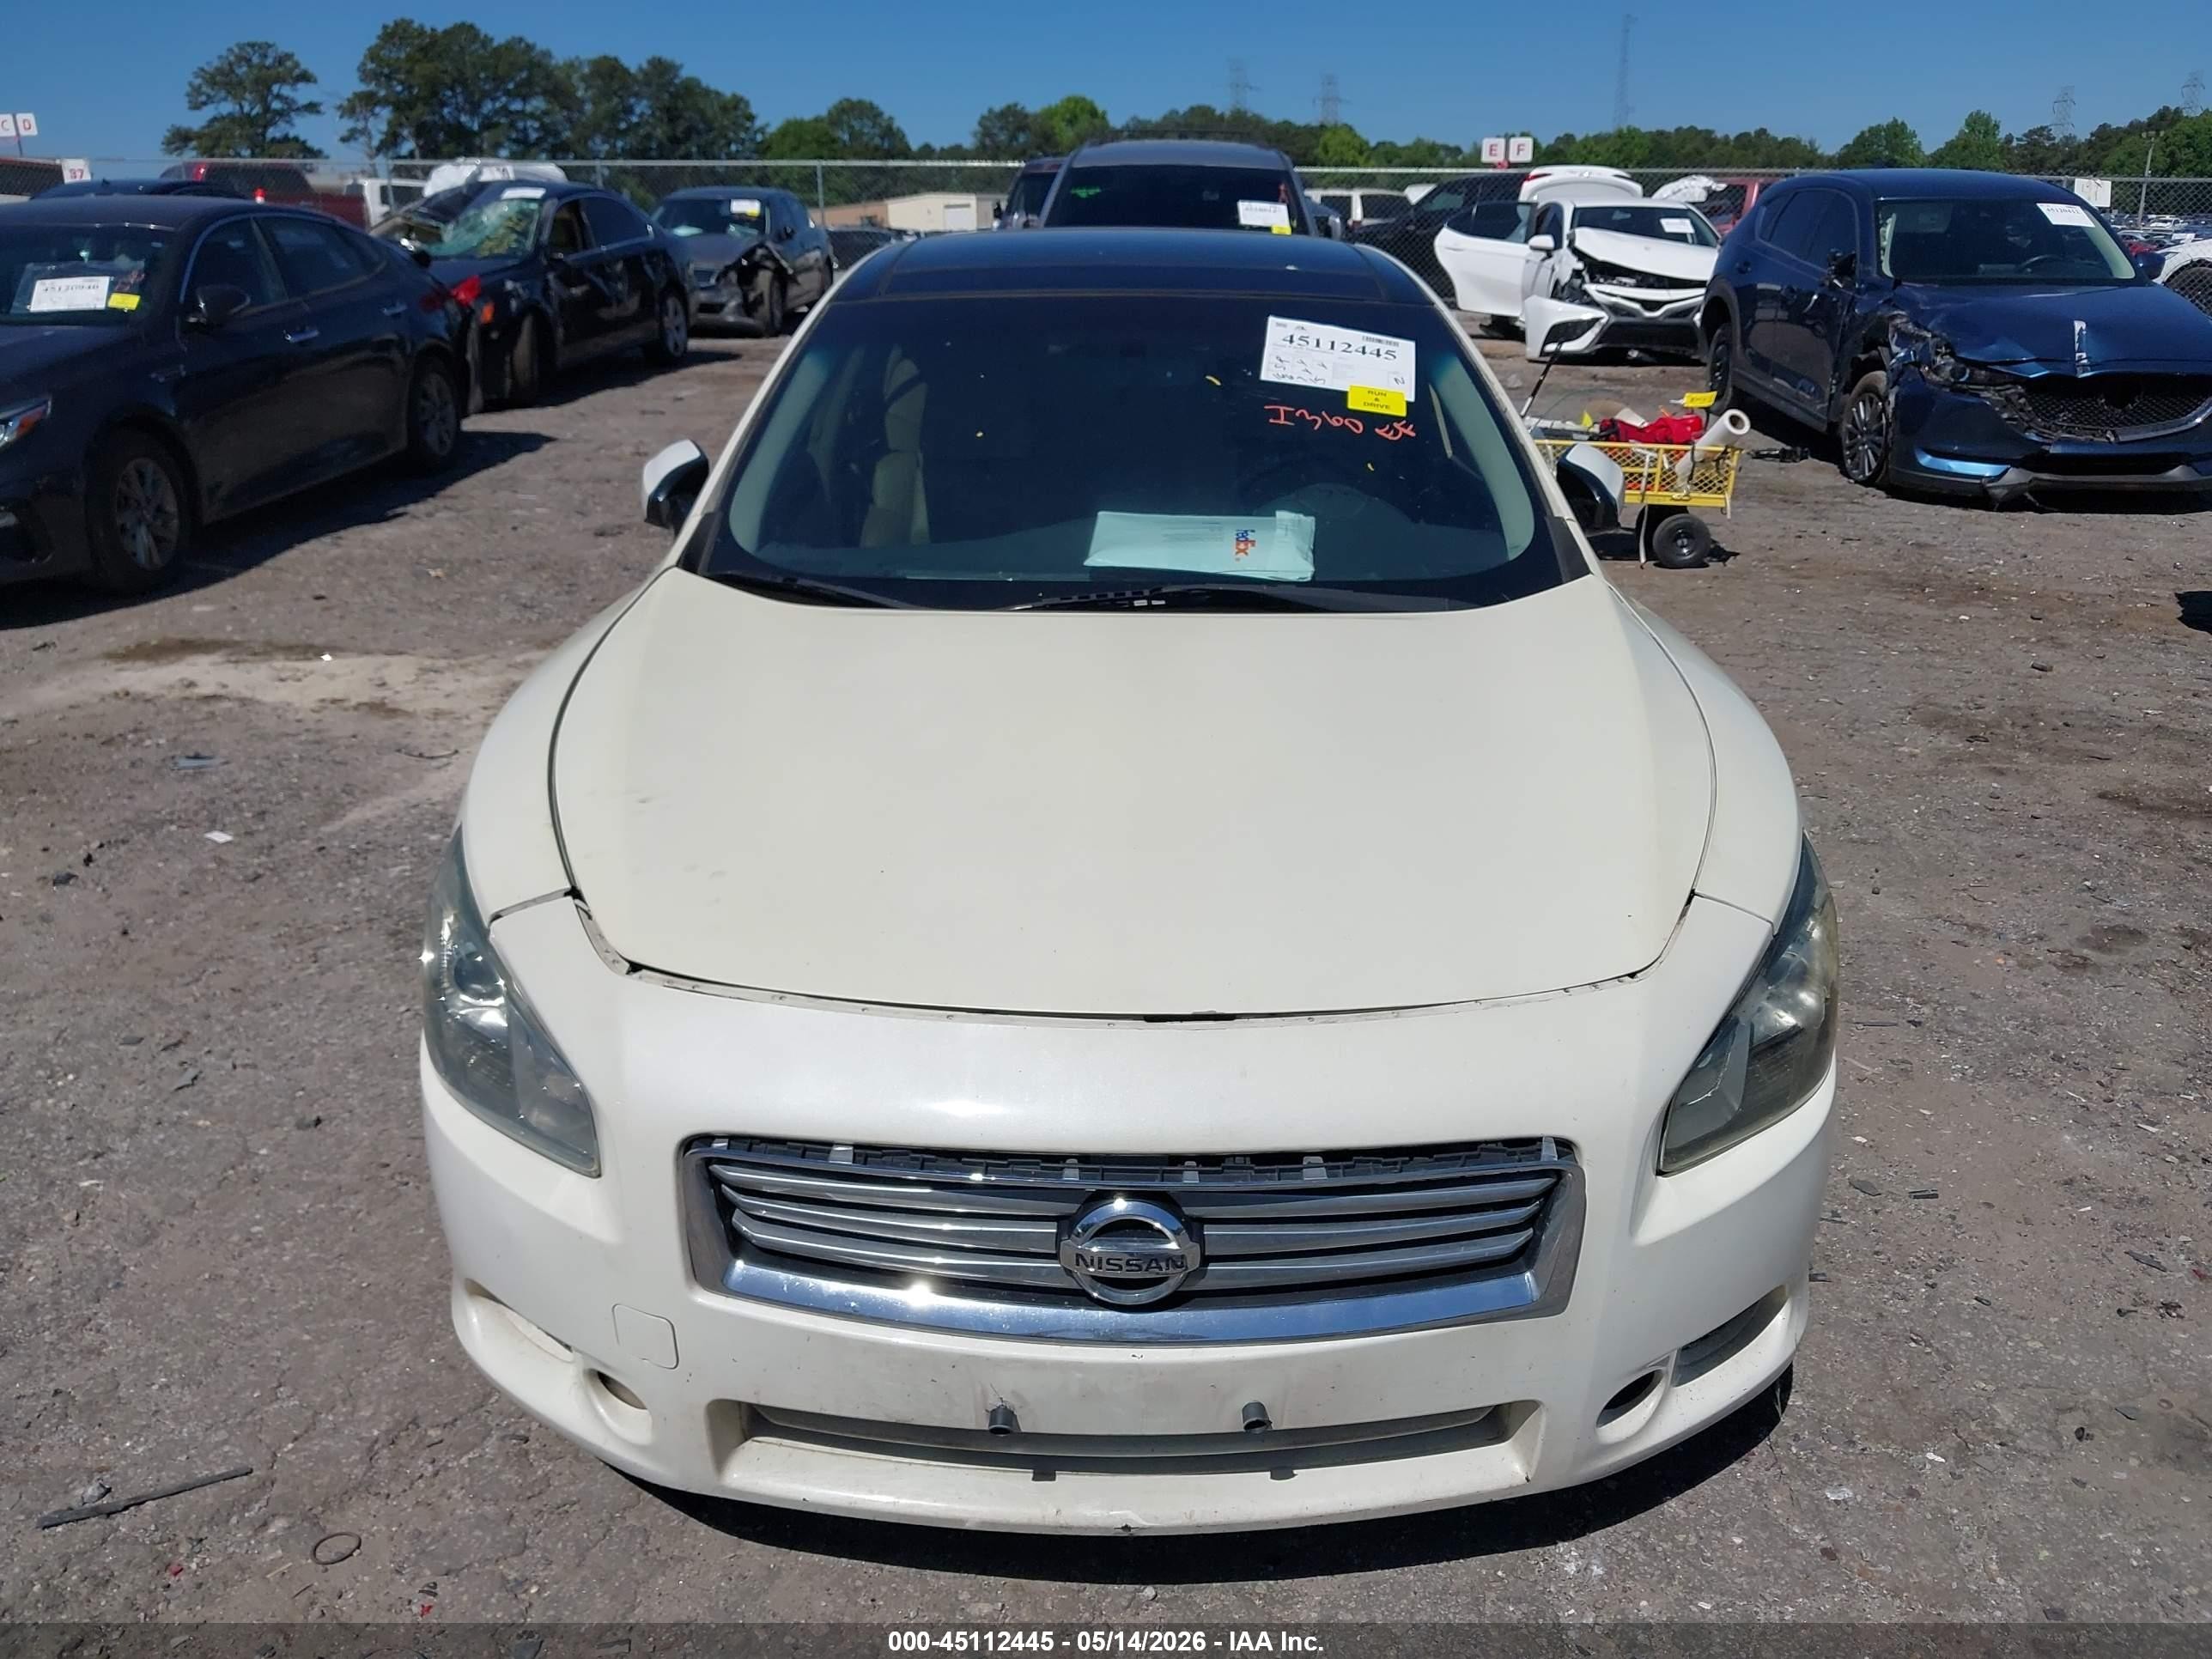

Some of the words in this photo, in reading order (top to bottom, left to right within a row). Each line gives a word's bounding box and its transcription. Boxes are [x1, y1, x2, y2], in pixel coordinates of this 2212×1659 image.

[1, 118, 10, 131] C
[22, 118, 32, 131] D
[1490, 143, 1498, 156] E
[1516, 143, 1526, 156] F
[1282, 333, 1398, 362] 45112445
[1367, 389, 1389, 398] RUN
[1363, 401, 1392, 411] DRIVE
[1074, 1252, 1189, 1274] NISSAN
